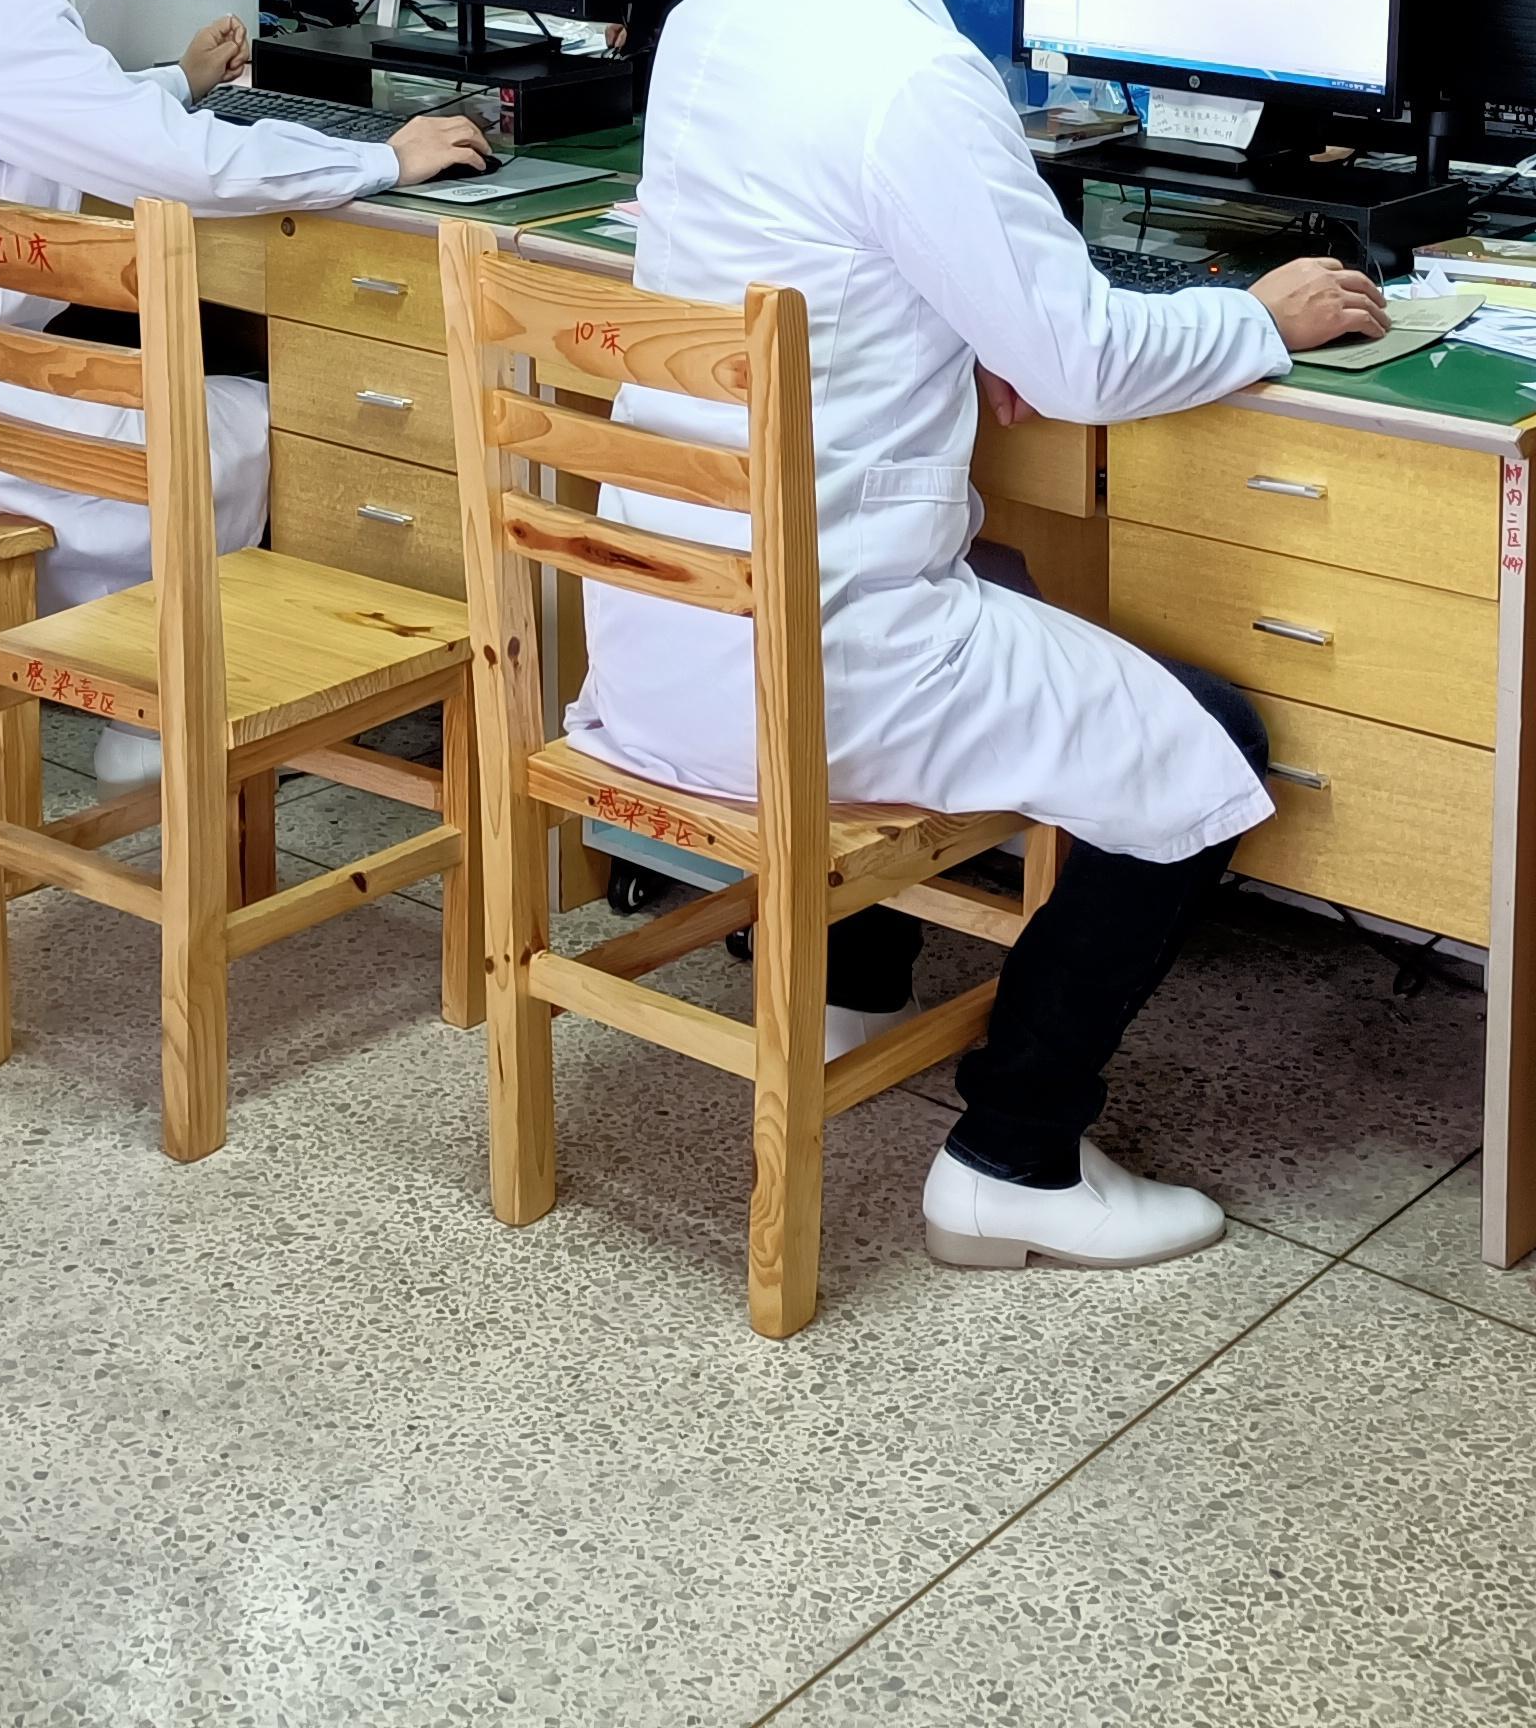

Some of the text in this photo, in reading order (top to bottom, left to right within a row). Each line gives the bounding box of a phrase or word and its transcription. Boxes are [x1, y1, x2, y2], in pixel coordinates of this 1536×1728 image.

[574, 320, 627, 357] 10床
[594, 786, 699, 848] 感染壹区
